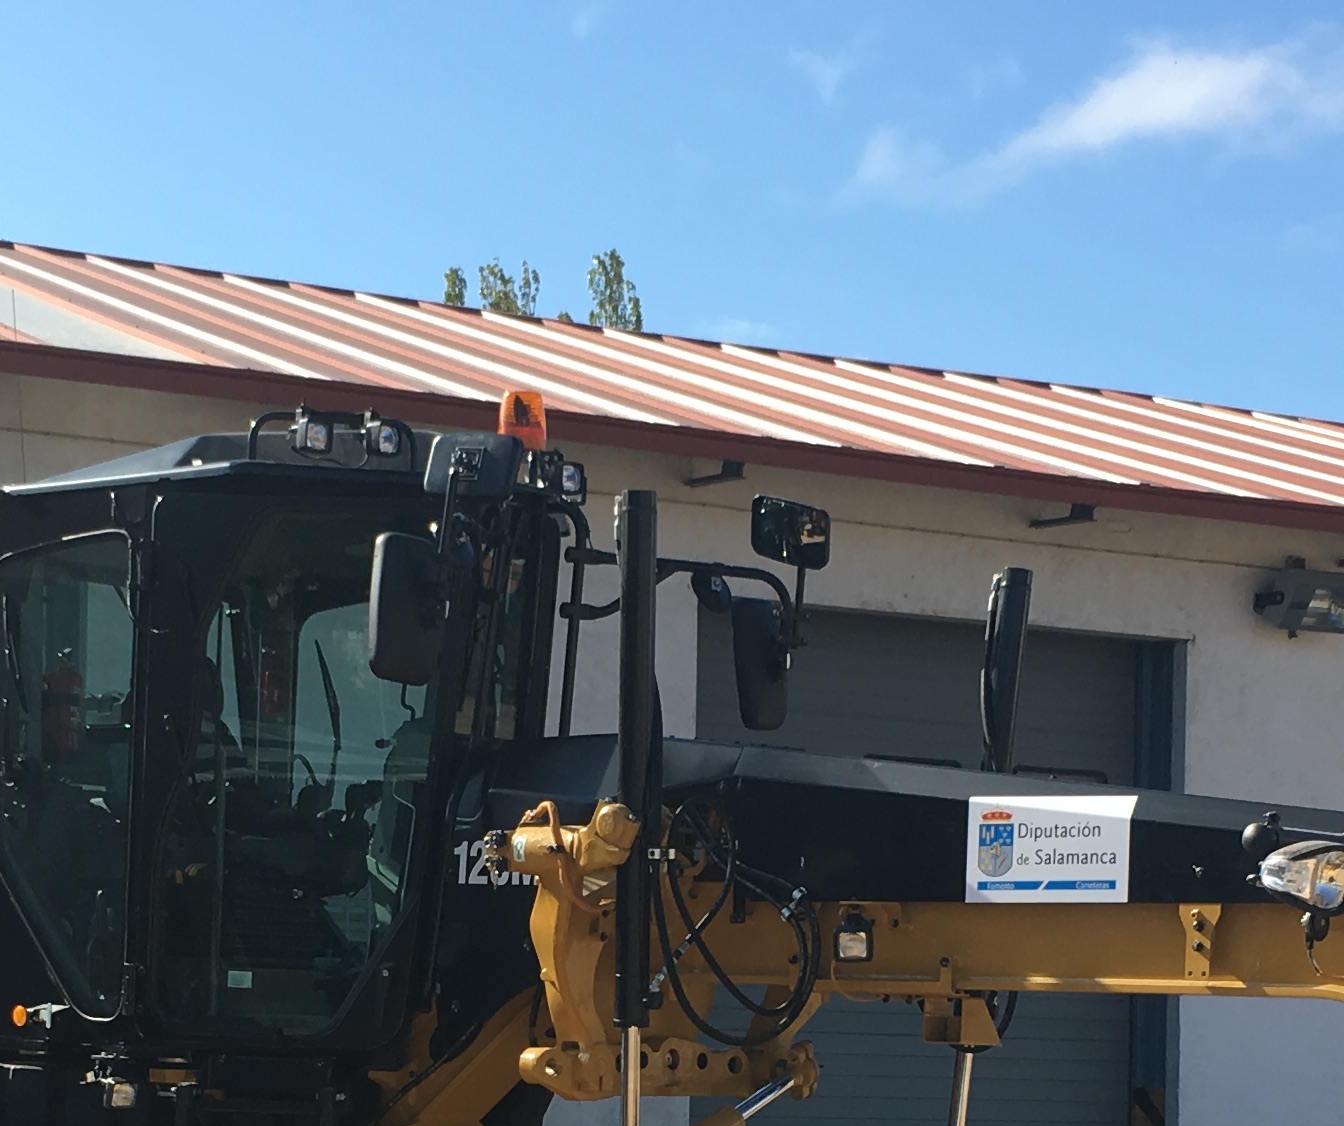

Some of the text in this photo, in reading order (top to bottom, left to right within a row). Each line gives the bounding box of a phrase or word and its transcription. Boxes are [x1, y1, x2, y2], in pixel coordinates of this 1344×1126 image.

[1018, 822, 1101, 842] Diputación
[453, 840, 540, 886] 12
[1016, 848, 1117, 866] de Salamanca
